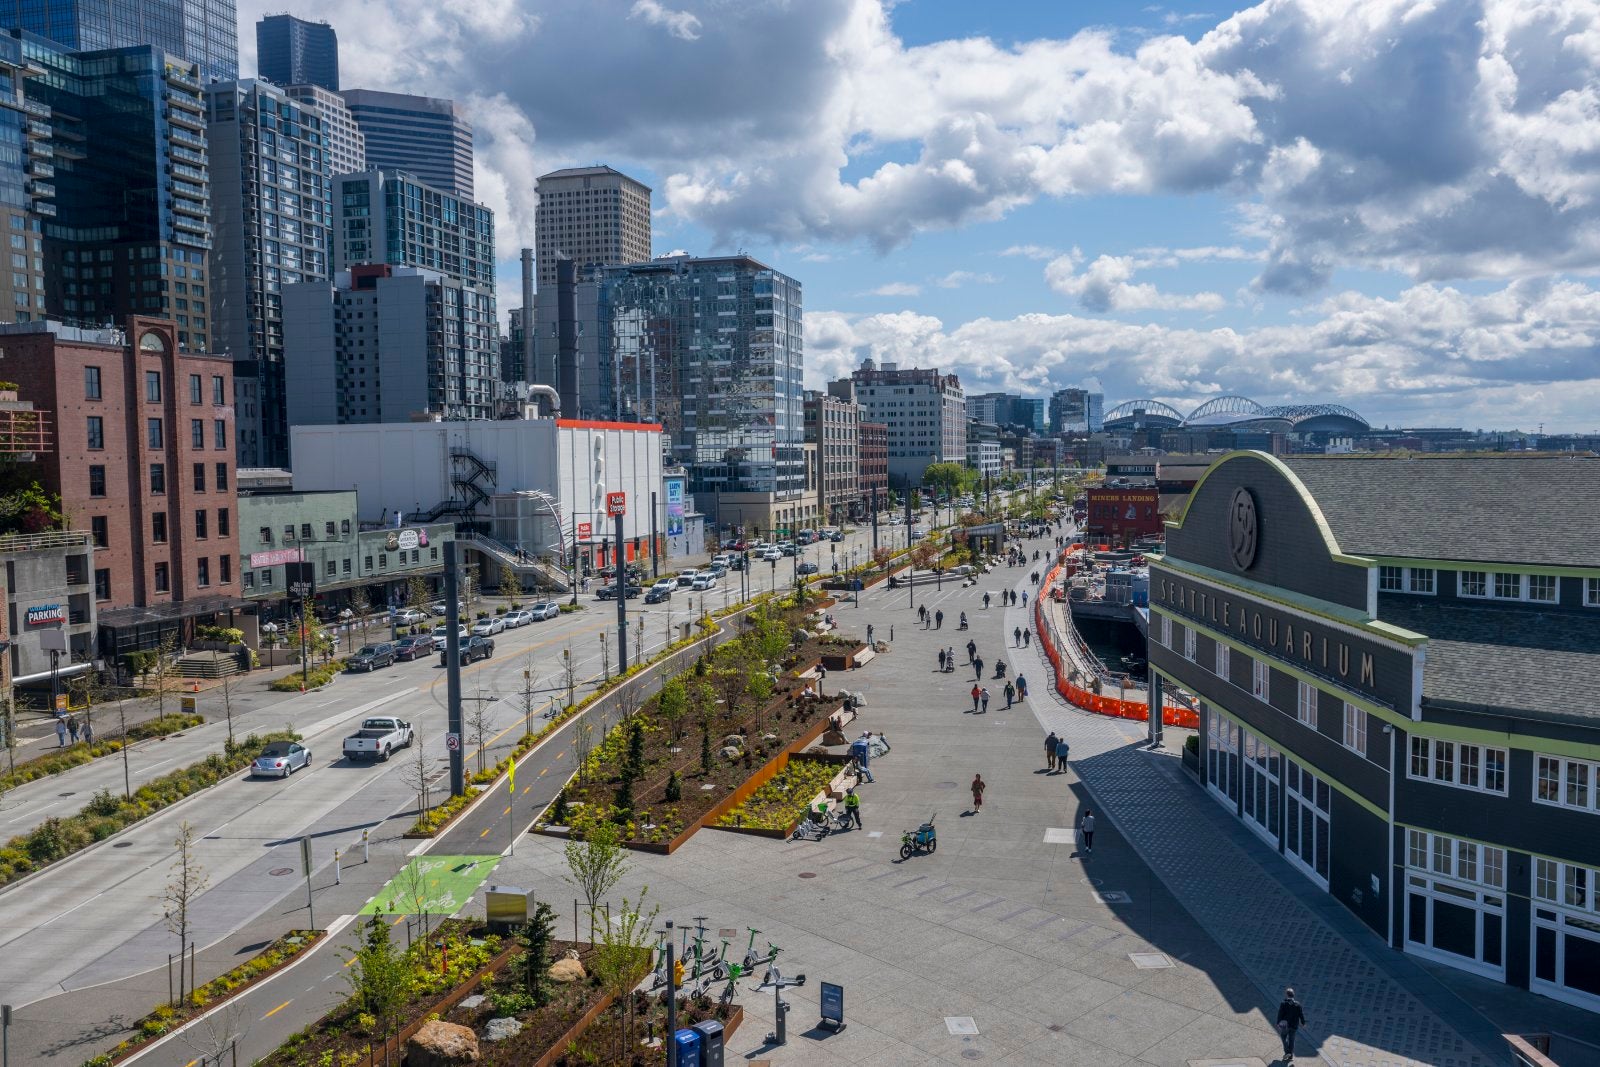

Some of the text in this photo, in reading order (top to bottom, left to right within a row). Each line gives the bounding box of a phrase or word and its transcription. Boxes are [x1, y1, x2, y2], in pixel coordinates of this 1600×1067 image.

[611, 495, 624, 503] Public
[609, 504, 625, 514] Storage
[28, 608, 62, 622] PARKING
[1161, 579, 1375, 688] SEATTLE AQUARIUM
